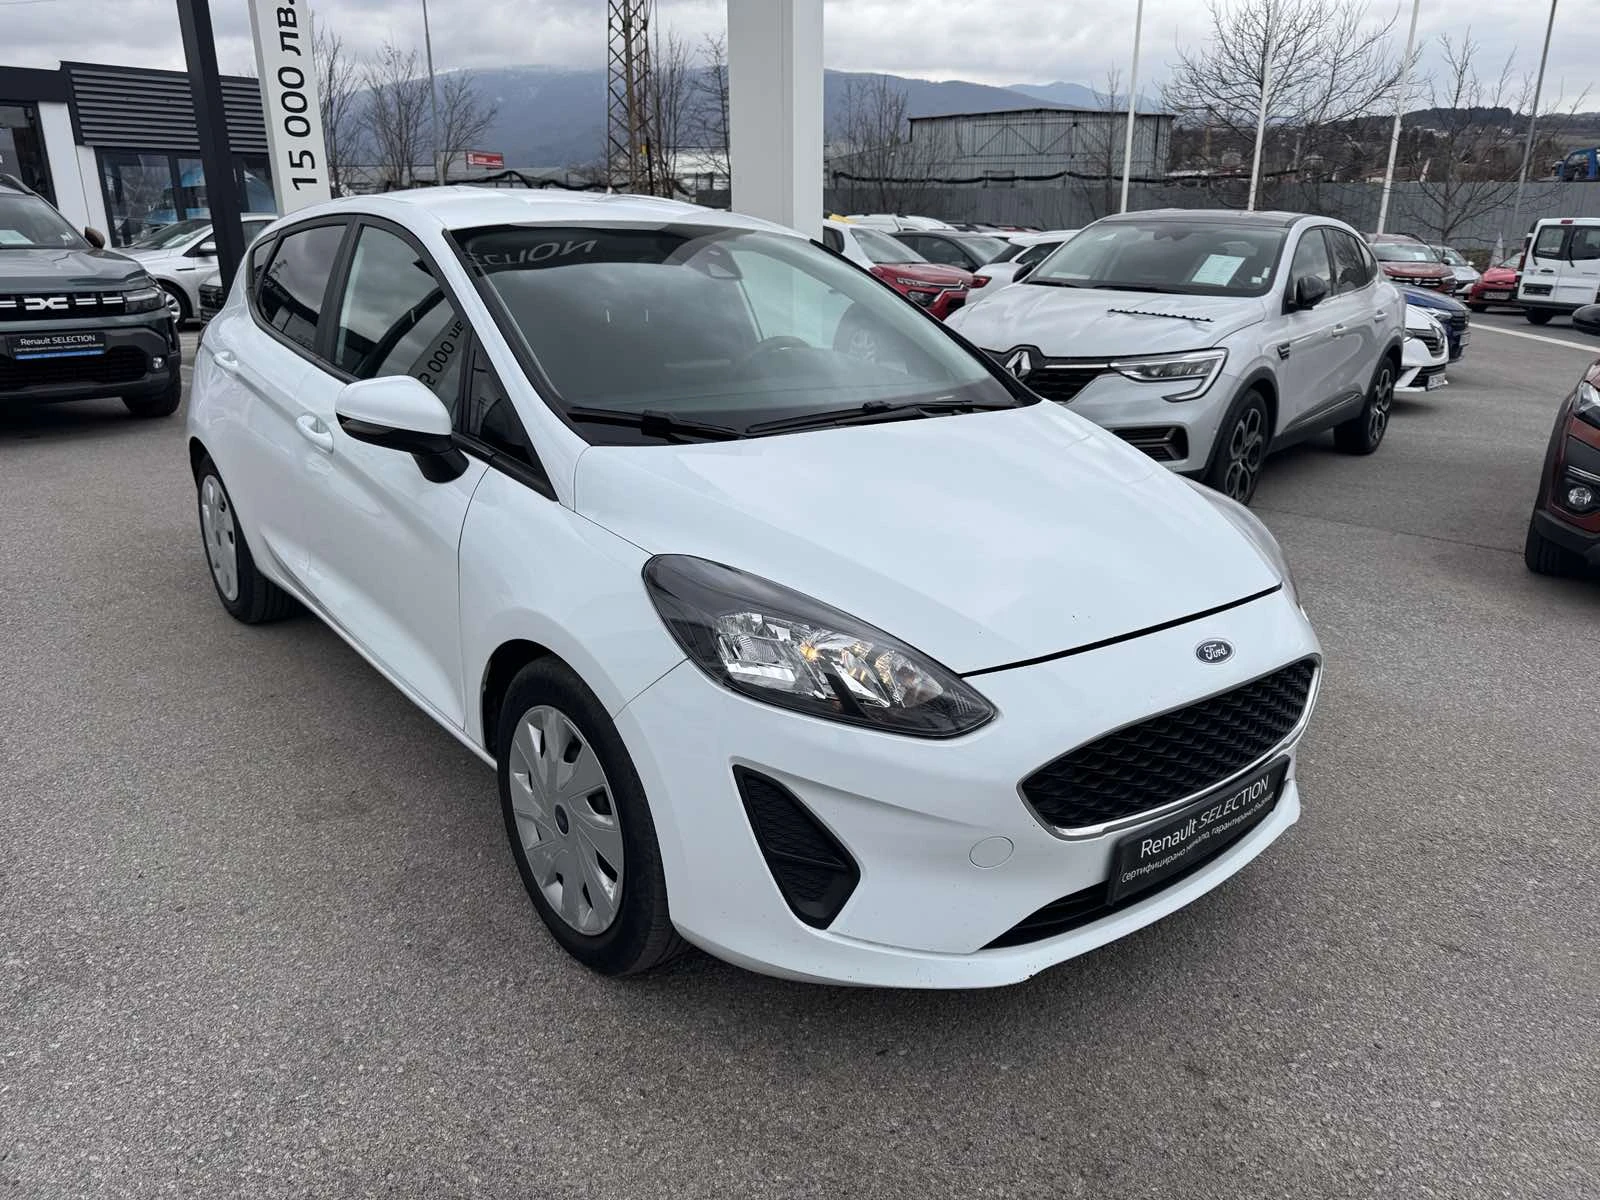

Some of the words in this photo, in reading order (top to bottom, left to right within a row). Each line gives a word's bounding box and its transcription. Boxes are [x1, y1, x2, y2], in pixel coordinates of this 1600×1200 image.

[277, 66, 312, 138] 000
[287, 149, 318, 191] 15
[20, 336, 51, 346] Renault
[52, 334, 96, 344] SELECTION
[1203, 643, 1228, 660] Ford
[1140, 818, 1197, 859] Renault
[1198, 775, 1270, 829] SELECTION
